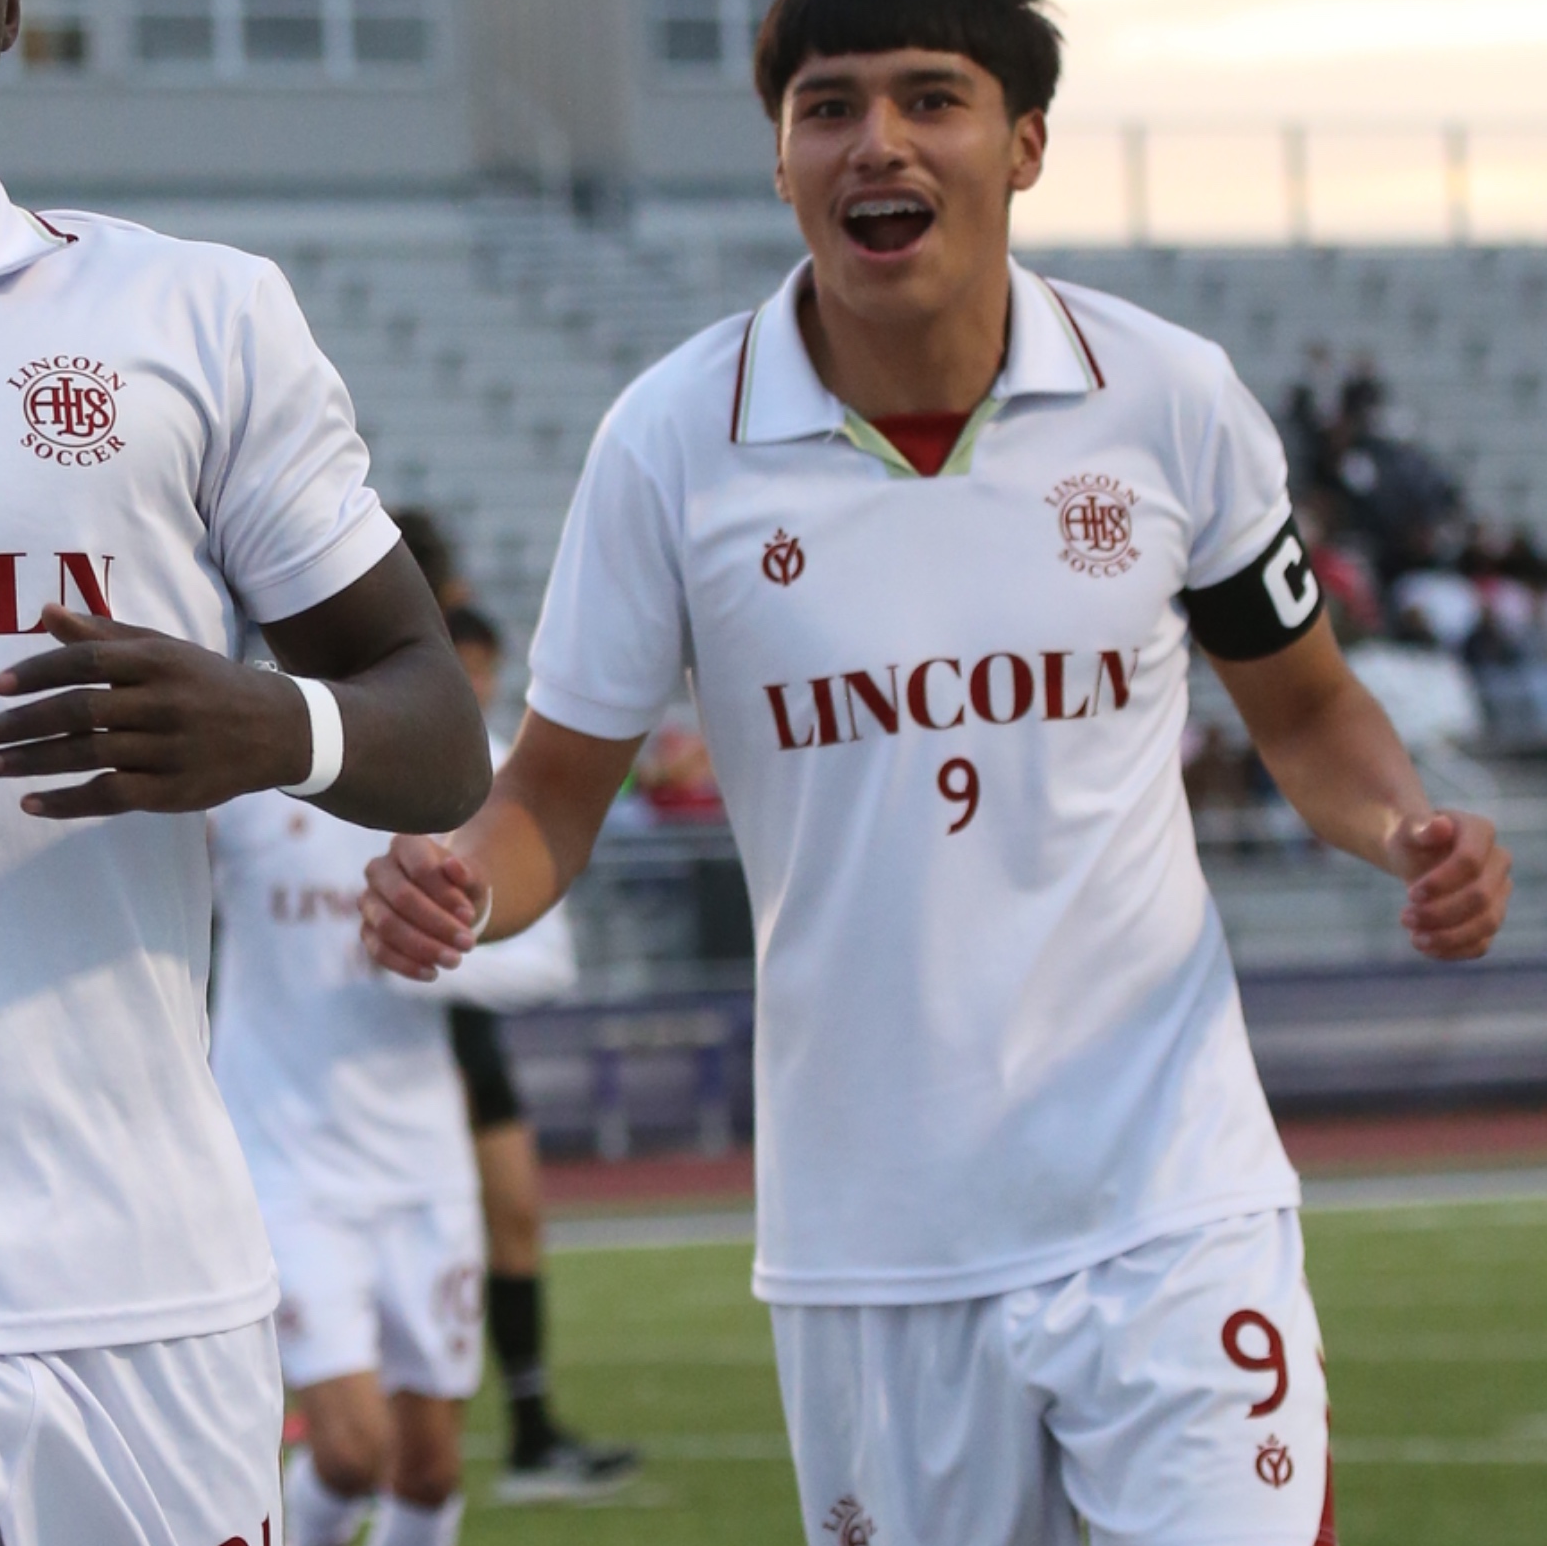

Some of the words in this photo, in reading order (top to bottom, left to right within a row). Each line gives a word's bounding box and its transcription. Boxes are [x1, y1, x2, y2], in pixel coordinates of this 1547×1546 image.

[7, 355, 128, 392] LINCOLN
[19, 431, 127, 468] SOCCER
[1262, 534, 1320, 629] C
[763, 650, 1140, 752] LINCOLN
[936, 757, 981, 836] 9
[1221, 1309, 1290, 1420] 9
